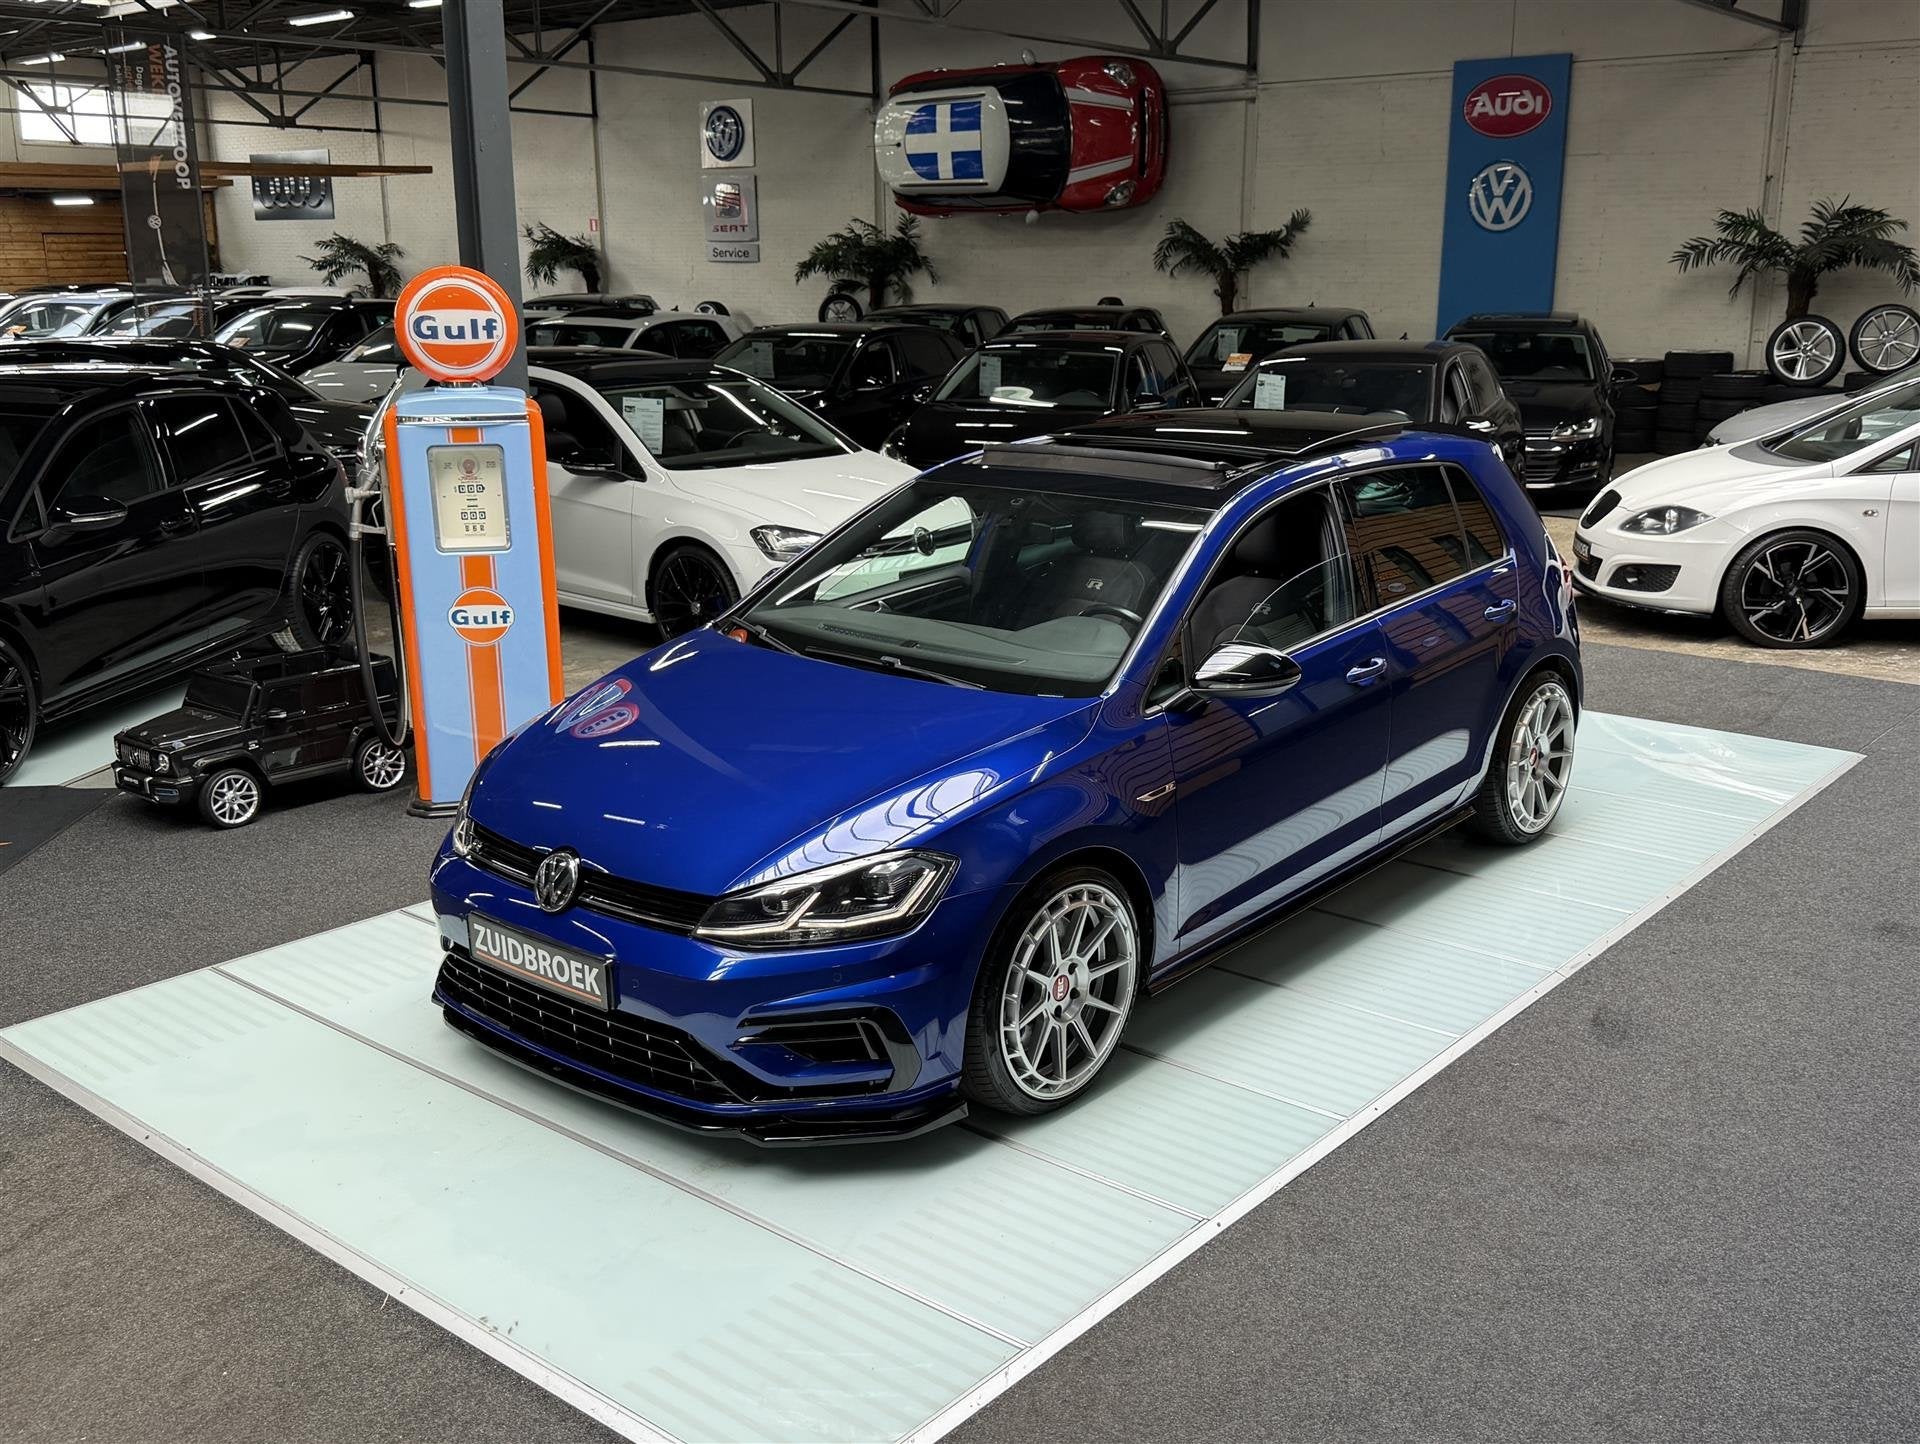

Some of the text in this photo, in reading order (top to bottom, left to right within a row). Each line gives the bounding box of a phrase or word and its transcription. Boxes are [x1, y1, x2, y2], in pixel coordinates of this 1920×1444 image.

[712, 224, 748, 233] SEAT
[712, 247, 750, 258] Service
[413, 315, 498, 340] Gulf
[451, 609, 511, 625] Gulf
[473, 923, 601, 996] ZUIDBROEK
